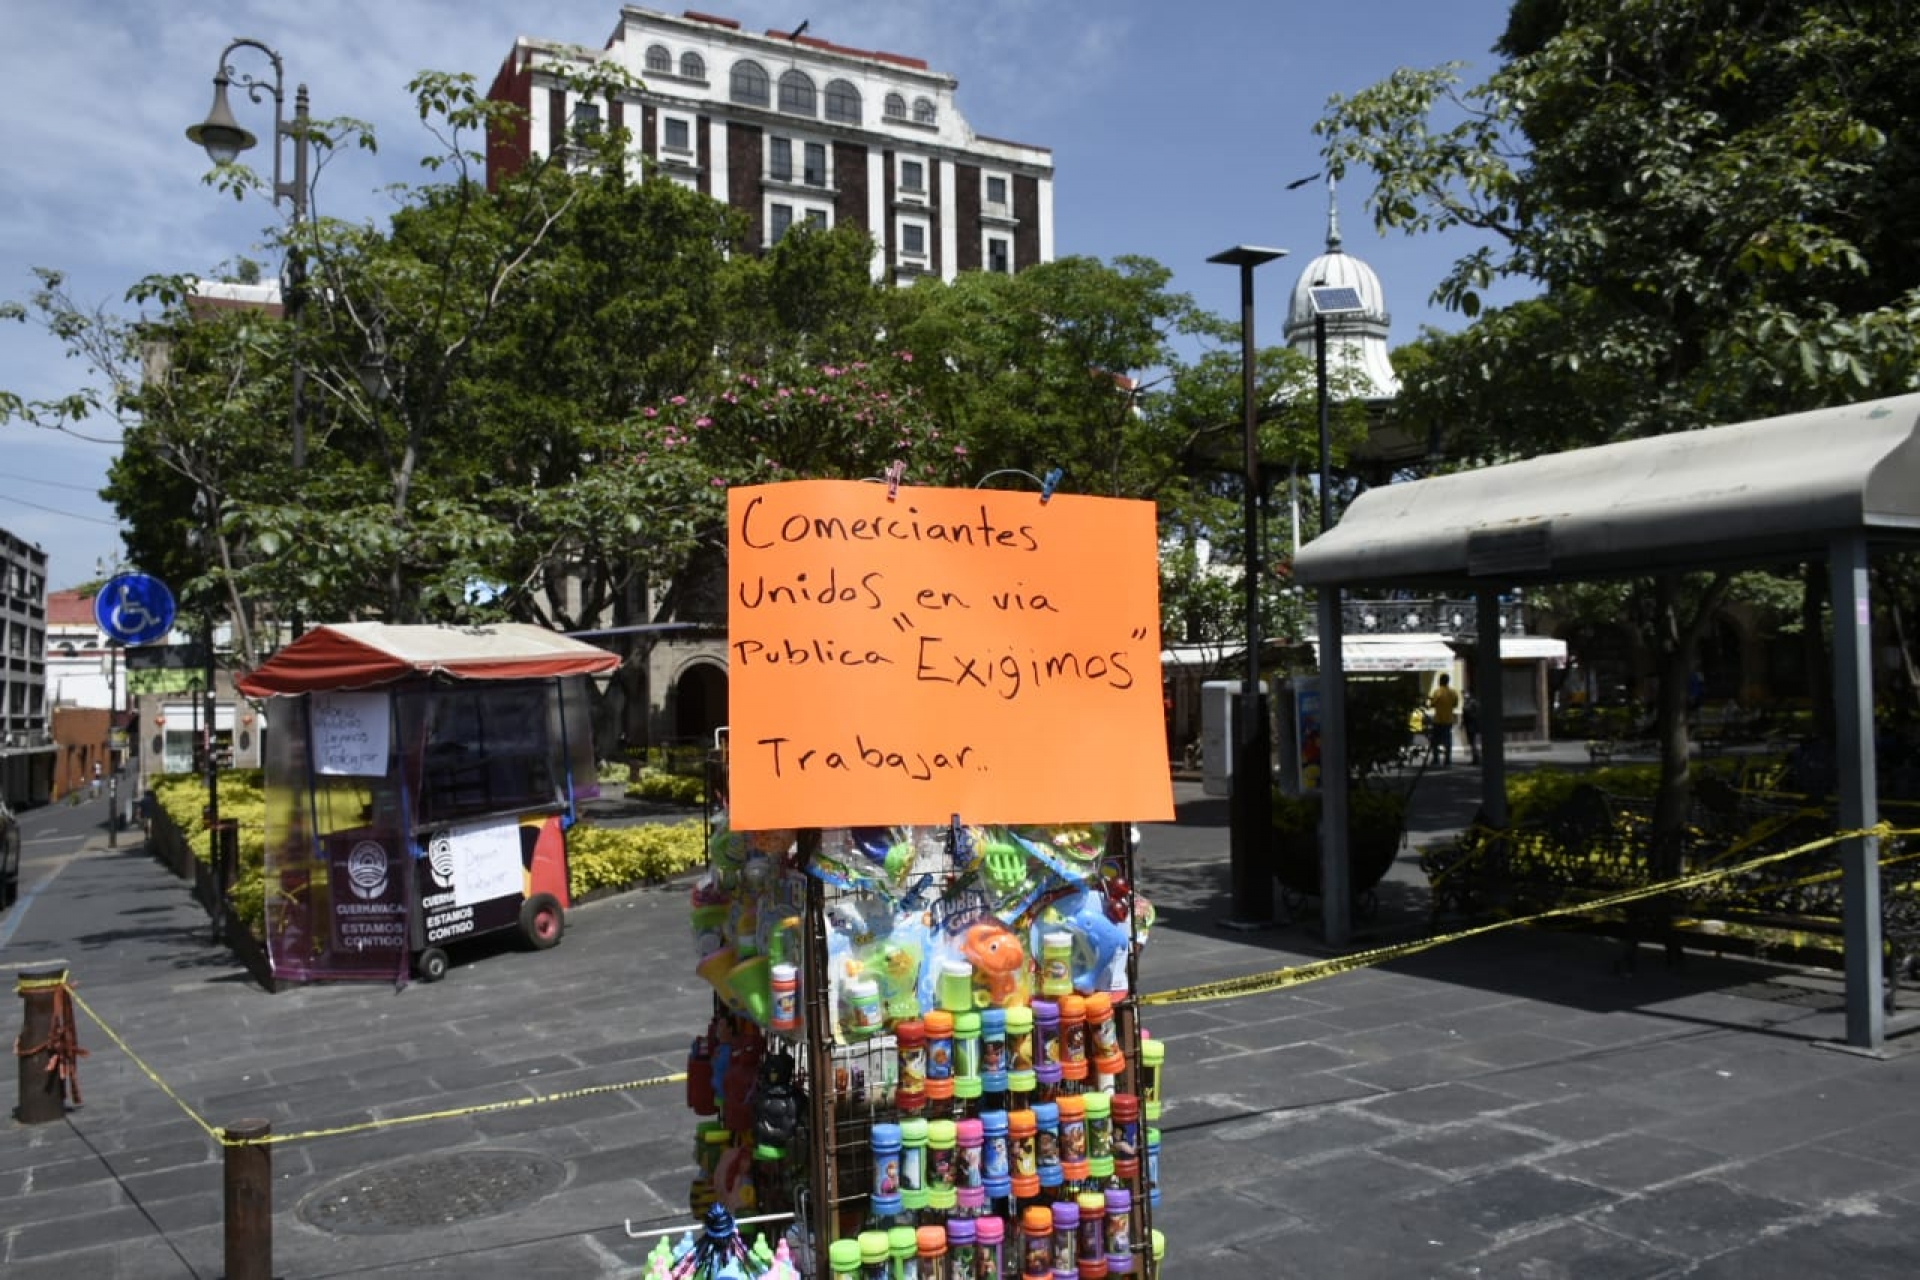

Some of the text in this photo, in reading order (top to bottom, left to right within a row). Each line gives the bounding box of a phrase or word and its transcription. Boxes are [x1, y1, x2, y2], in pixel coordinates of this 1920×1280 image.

[741, 496, 1038, 551] Comerciantes
[739, 568, 1059, 613] Unidos en via
[733, 639, 894, 666] Publica
[341, 922, 404, 935] ESTAMOS
[425, 906, 474, 930] ESTAMOS
[343, 935, 404, 947] CONTIGO
[428, 919, 474, 942] CONTIGO
